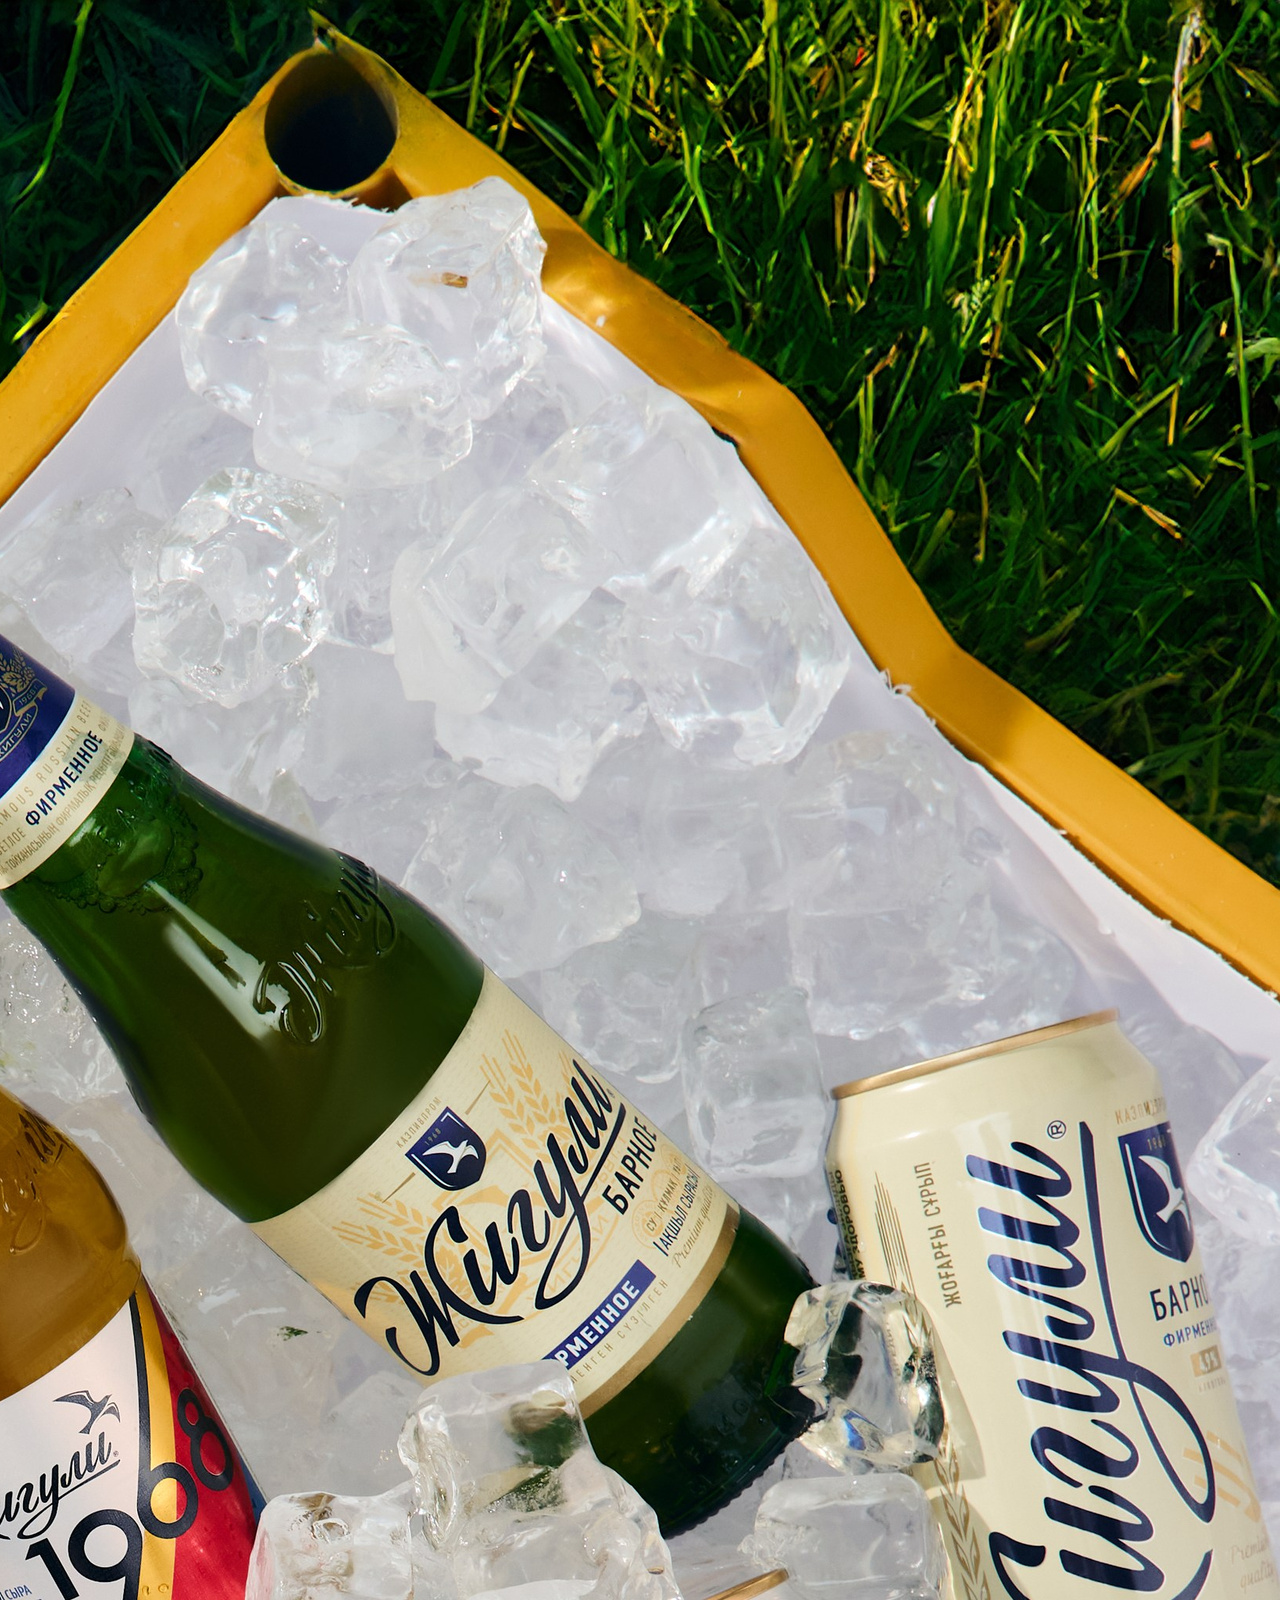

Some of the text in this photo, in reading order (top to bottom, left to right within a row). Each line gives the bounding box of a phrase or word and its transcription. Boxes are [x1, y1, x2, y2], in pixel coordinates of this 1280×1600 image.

[25, 729, 104, 827] ФИРМЕННОЕ
[36, 728, 81, 783] RUSSIAN
[396, 1097, 442, 1149] КАЗПИВПРОМ
[602, 1115, 657, 1215] БАРНОЕ
[353, 1059, 627, 1377] Жигули
[671, 1215, 704, 1268] Premium
[913, 1162, 962, 1308] ЖОҒАРҒЫ СҰРЫП
[555, 1279, 640, 1369] РМЕННОЕ
[1149, 1273, 1210, 1322] БАРНО
[4, 1585, 33, 1600] СЫРА
